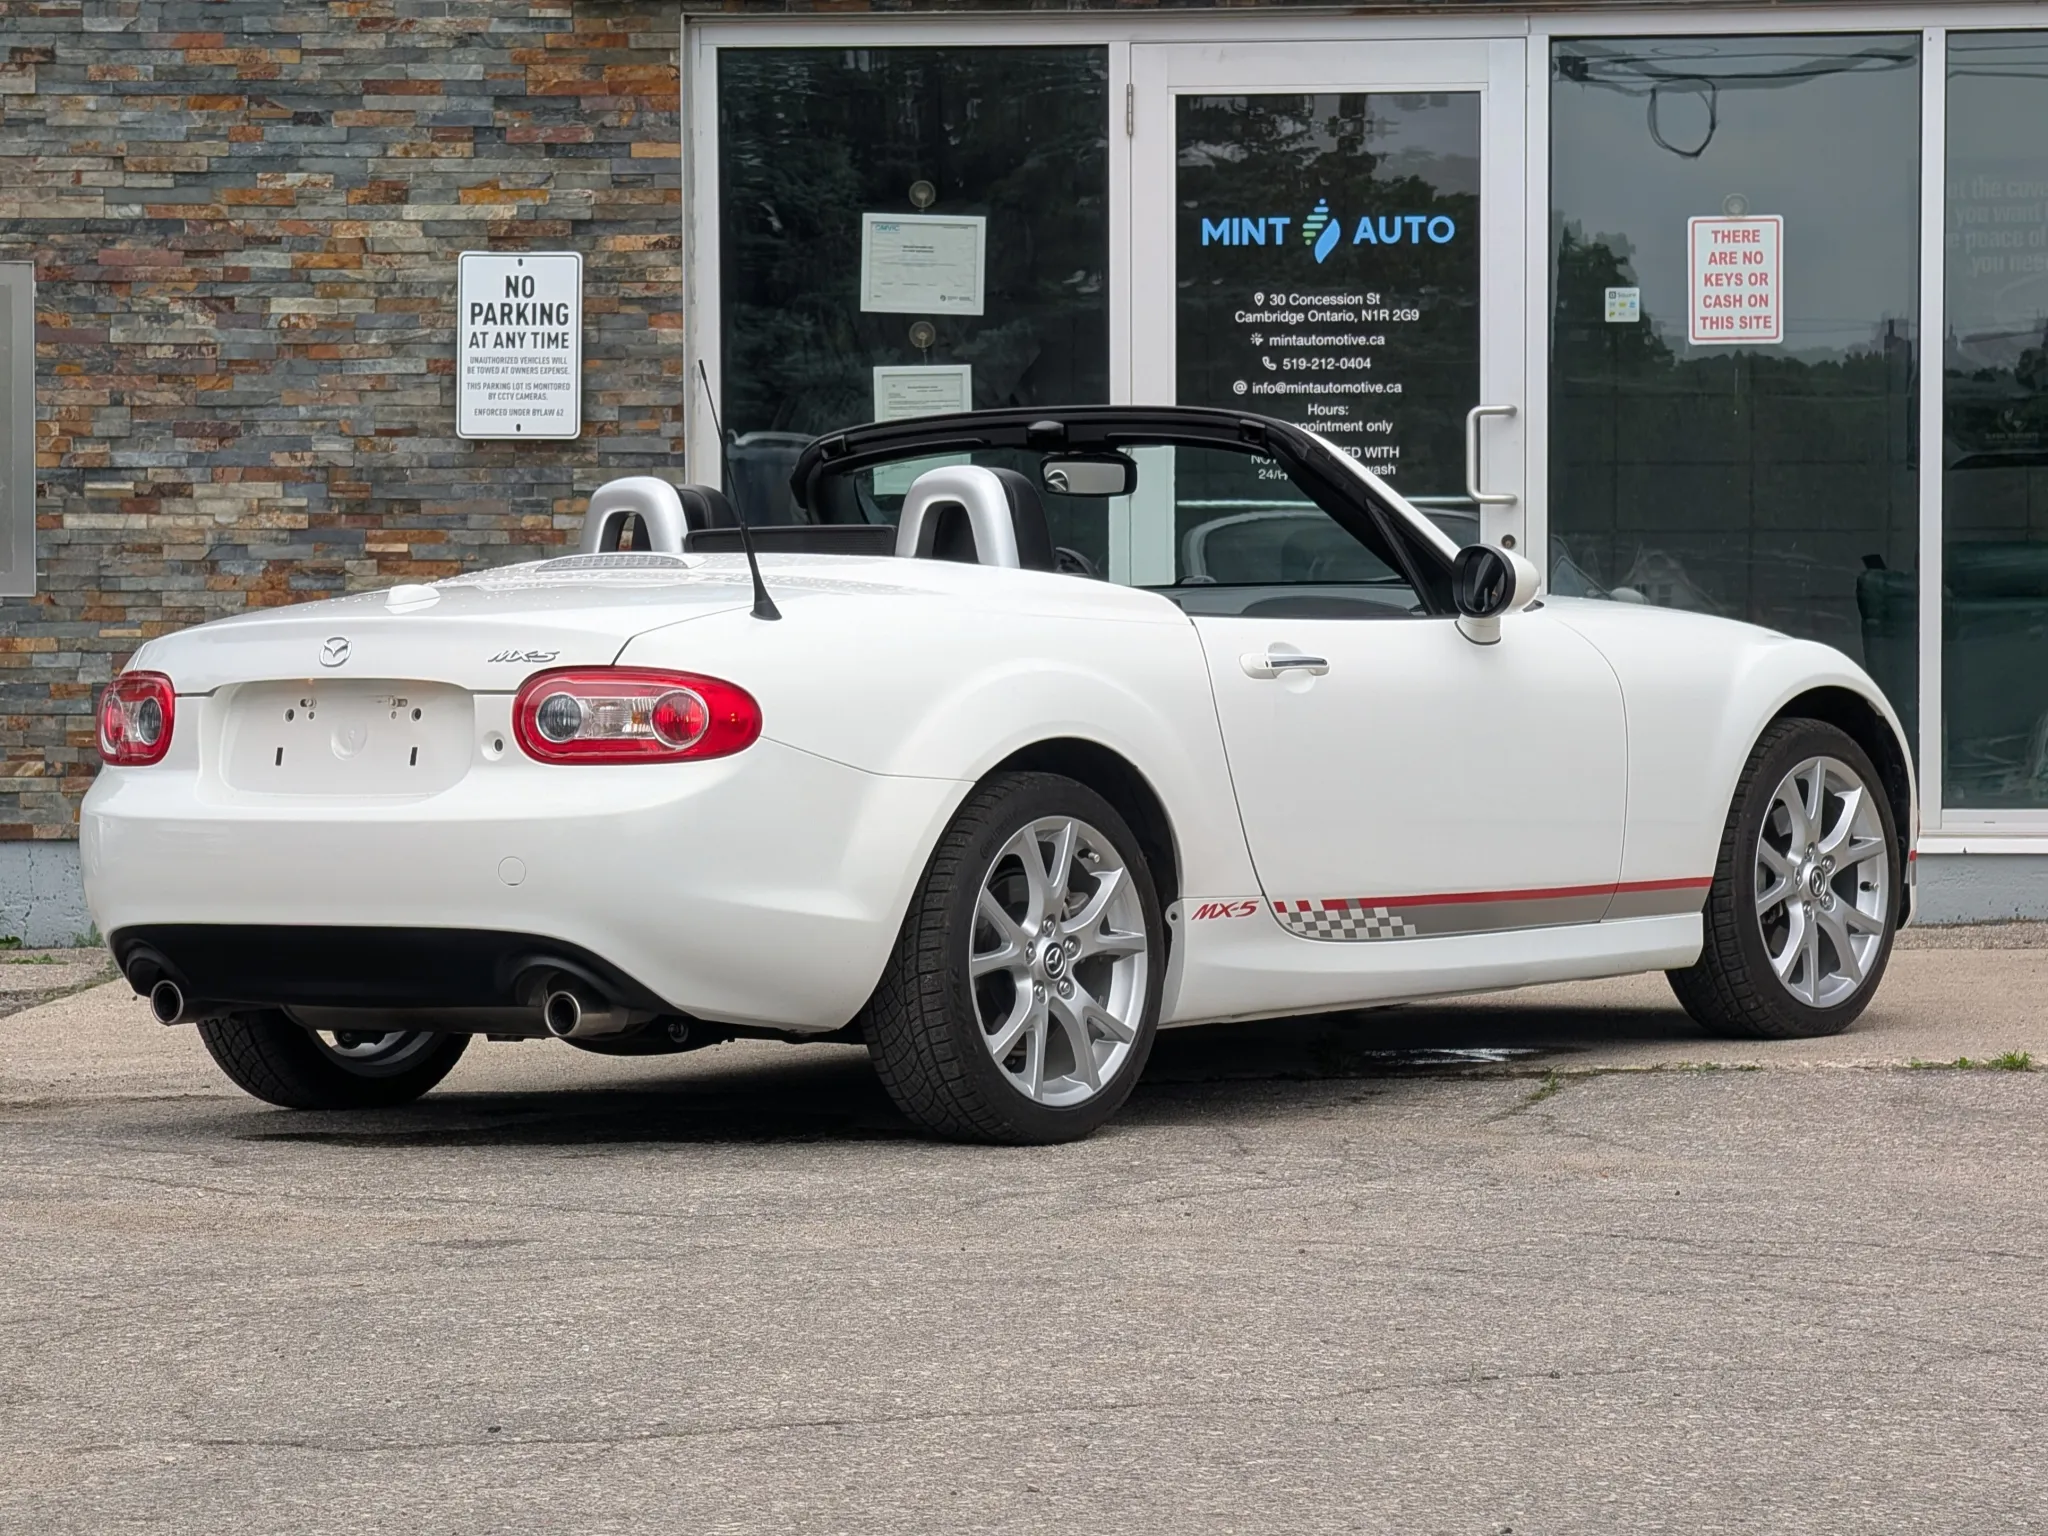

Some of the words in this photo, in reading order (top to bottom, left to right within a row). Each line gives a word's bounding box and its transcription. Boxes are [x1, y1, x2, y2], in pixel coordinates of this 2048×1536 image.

[1201, 217, 1291, 246] MINT
[1352, 215, 1455, 245] AUTO
[1711, 229, 1761, 244] THERE
[1708, 251, 1738, 265] ARE
[1742, 251, 1764, 265] NO
[505, 275, 535, 298] NO
[1704, 272, 1743, 287] KEYS
[1748, 272, 1769, 286] OR
[1269, 293, 1286, 306] 30
[1289, 293, 1363, 306] Concession
[1366, 292, 1381, 305] St
[1702, 294, 1743, 308] CASH
[1748, 294, 1769, 308] ON
[470, 302, 569, 326] PARKING
[1234, 310, 1305, 325] Cambridge
[1307, 309, 1358, 323] Ontario,
[1361, 309, 1390, 322] N1R
[1392, 309, 1420, 321] 2G9
[1700, 316, 1734, 330] THIS
[1739, 315, 1772, 329] SITE
[468, 331, 489, 349] AT
[493, 331, 527, 349] ANY
[531, 332, 570, 349] TIME
[1269, 333, 1386, 346] mintautomotive.ca
[469, 356, 519, 365] UNAUTHORIZED
[520, 356, 550, 365] VEHICLES
[551, 356, 568, 365] WILL
[1282, 357, 1372, 370] 519-212-0404
[467, 366, 475, 374] BE
[477, 366, 500, 375] TOWED
[501, 366, 509, 375] AT
[510, 366, 539, 375] OWNERS
[540, 366, 570, 375] EXPENSE.
[466, 382, 481, 390] THIS
[483, 382, 511, 390] PARKING
[512, 382, 524, 390] LOT
[525, 382, 532, 390] IS
[533, 382, 571, 391] MONITORED
[1252, 381, 1402, 395] info@mintautomotive.ca
[488, 392, 497, 400] BY
[497, 392, 515, 400] CCTV
[515, 393, 548, 401] CAMERAS.
[474, 408, 508, 416] ENFORCED
[509, 408, 531, 416] UNDER
[1307, 403, 1349, 416] Hours:
[1366, 420, 1393, 434] only
[1364, 446, 1400, 458] WITH
[1191, 900, 1259, 920] MX-5
